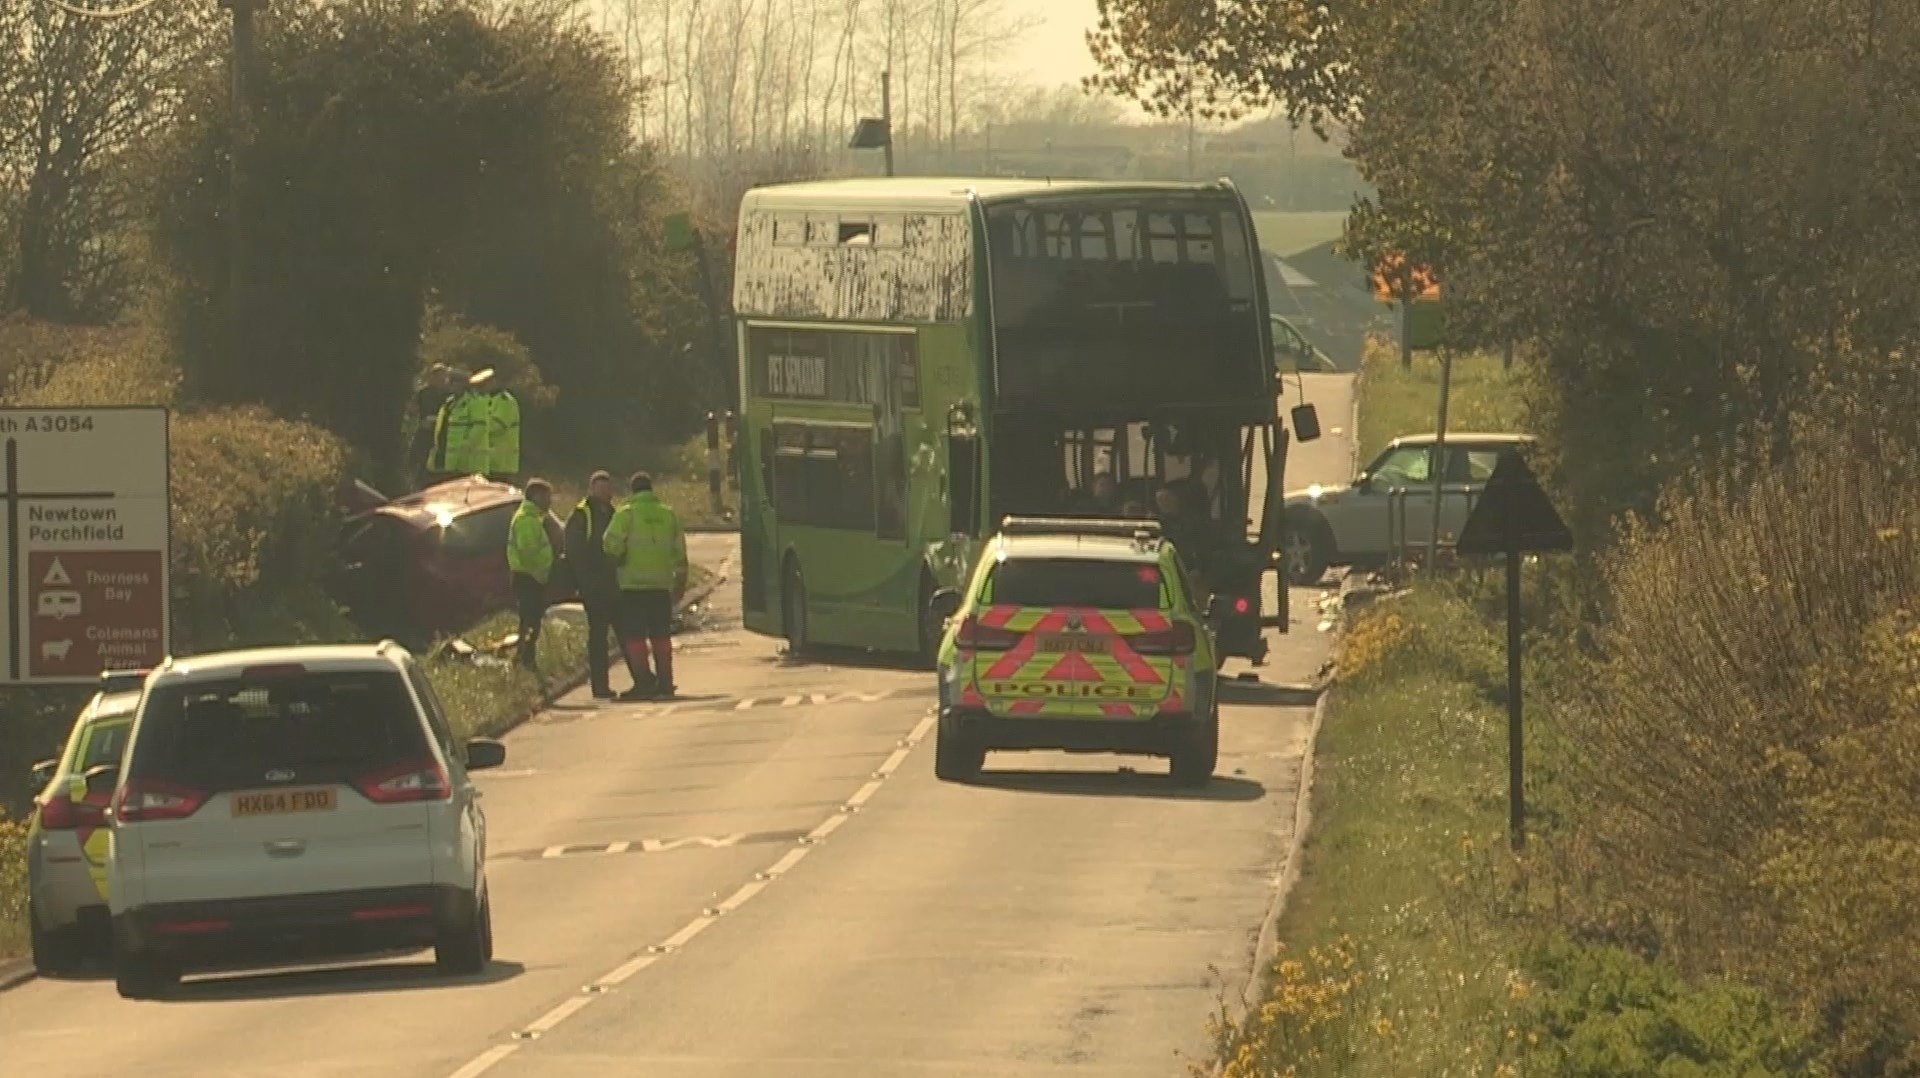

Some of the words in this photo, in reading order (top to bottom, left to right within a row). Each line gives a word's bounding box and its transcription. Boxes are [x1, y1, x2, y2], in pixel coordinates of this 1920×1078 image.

[25, 415, 94, 433] A3054
[28, 505, 117, 522] Newtown
[29, 524, 124, 542] Porchfield
[86, 569, 149, 585] Thorness
[105, 587, 132, 602] Bay
[86, 626, 158, 640] Colemans
[97, 641, 147, 656] Animal
[104, 657, 142, 669] Farm
[994, 682, 1151, 699] POLICE
[238, 794, 286, 814] HX64
